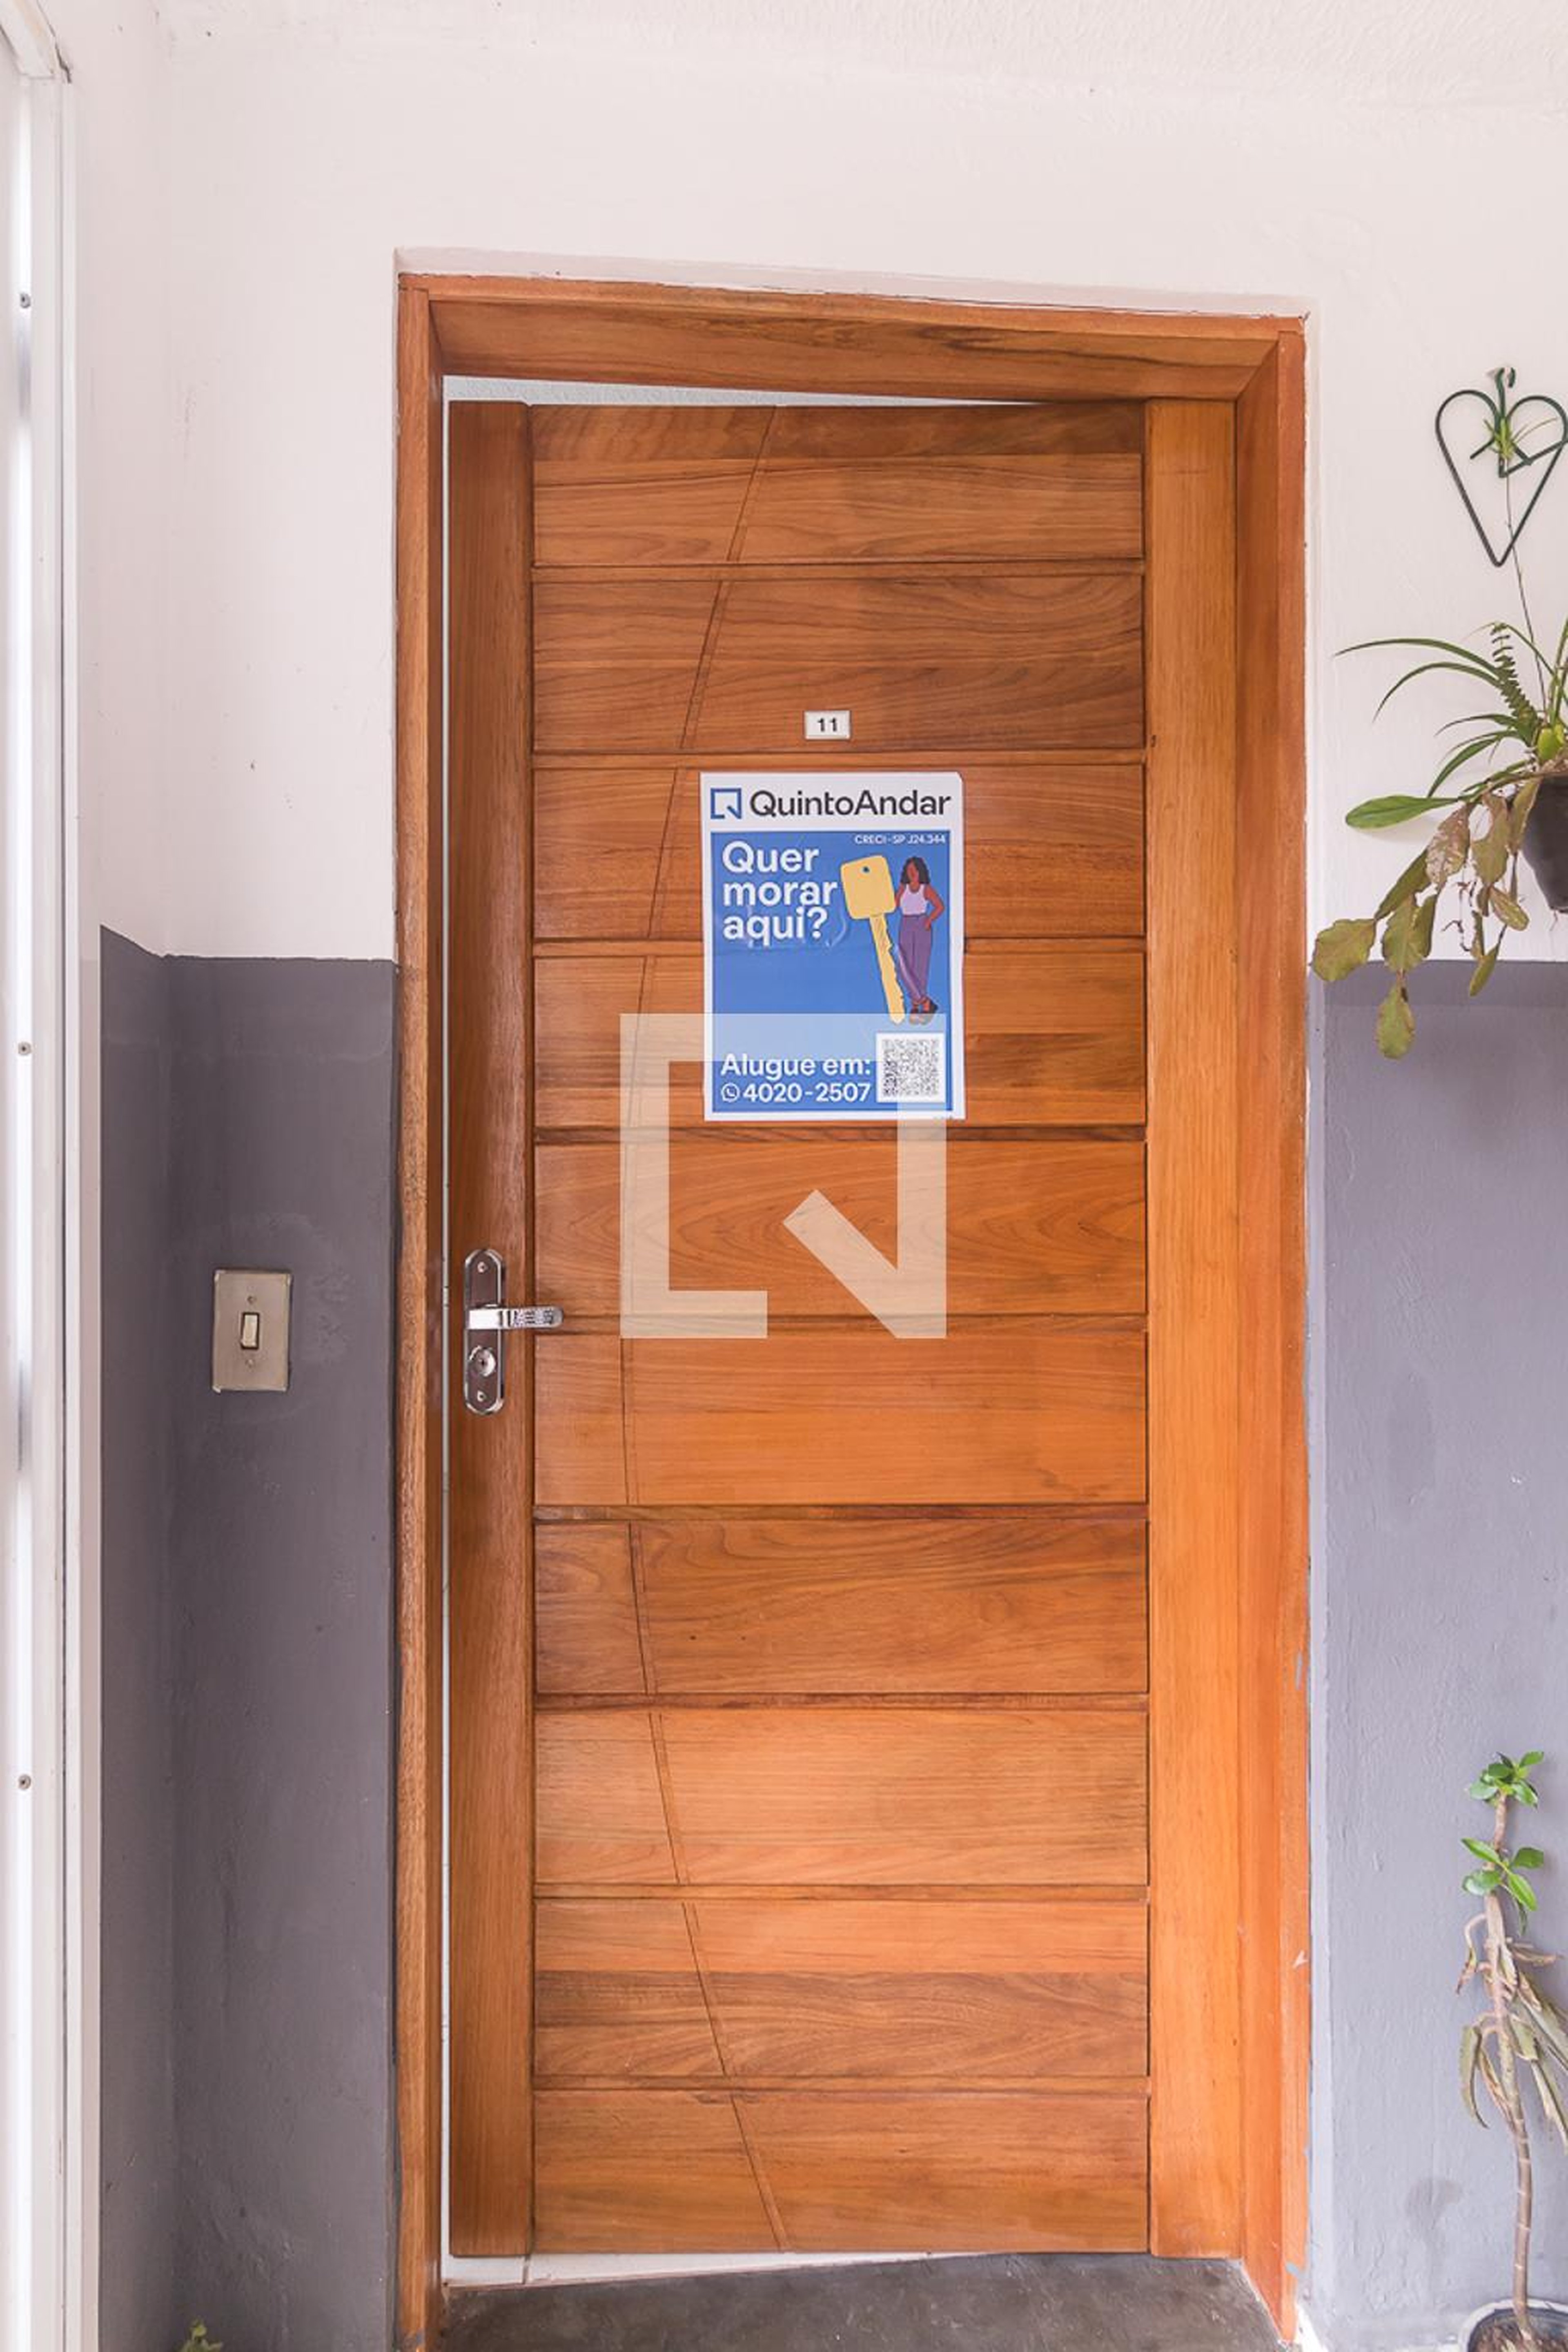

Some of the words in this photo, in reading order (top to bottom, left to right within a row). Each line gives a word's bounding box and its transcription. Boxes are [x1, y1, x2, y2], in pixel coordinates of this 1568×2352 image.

[817, 717, 837, 731] 11
[750, 790, 951, 817] QuintoAndar
[722, 841, 819, 874] Quer
[723, 880, 838, 906] morar
[723, 906, 828, 946] aqui?
[721, 1054, 816, 1081] Alugue
[822, 1058, 871, 1076] em:
[742, 1083, 871, 1102] 4020-2507
